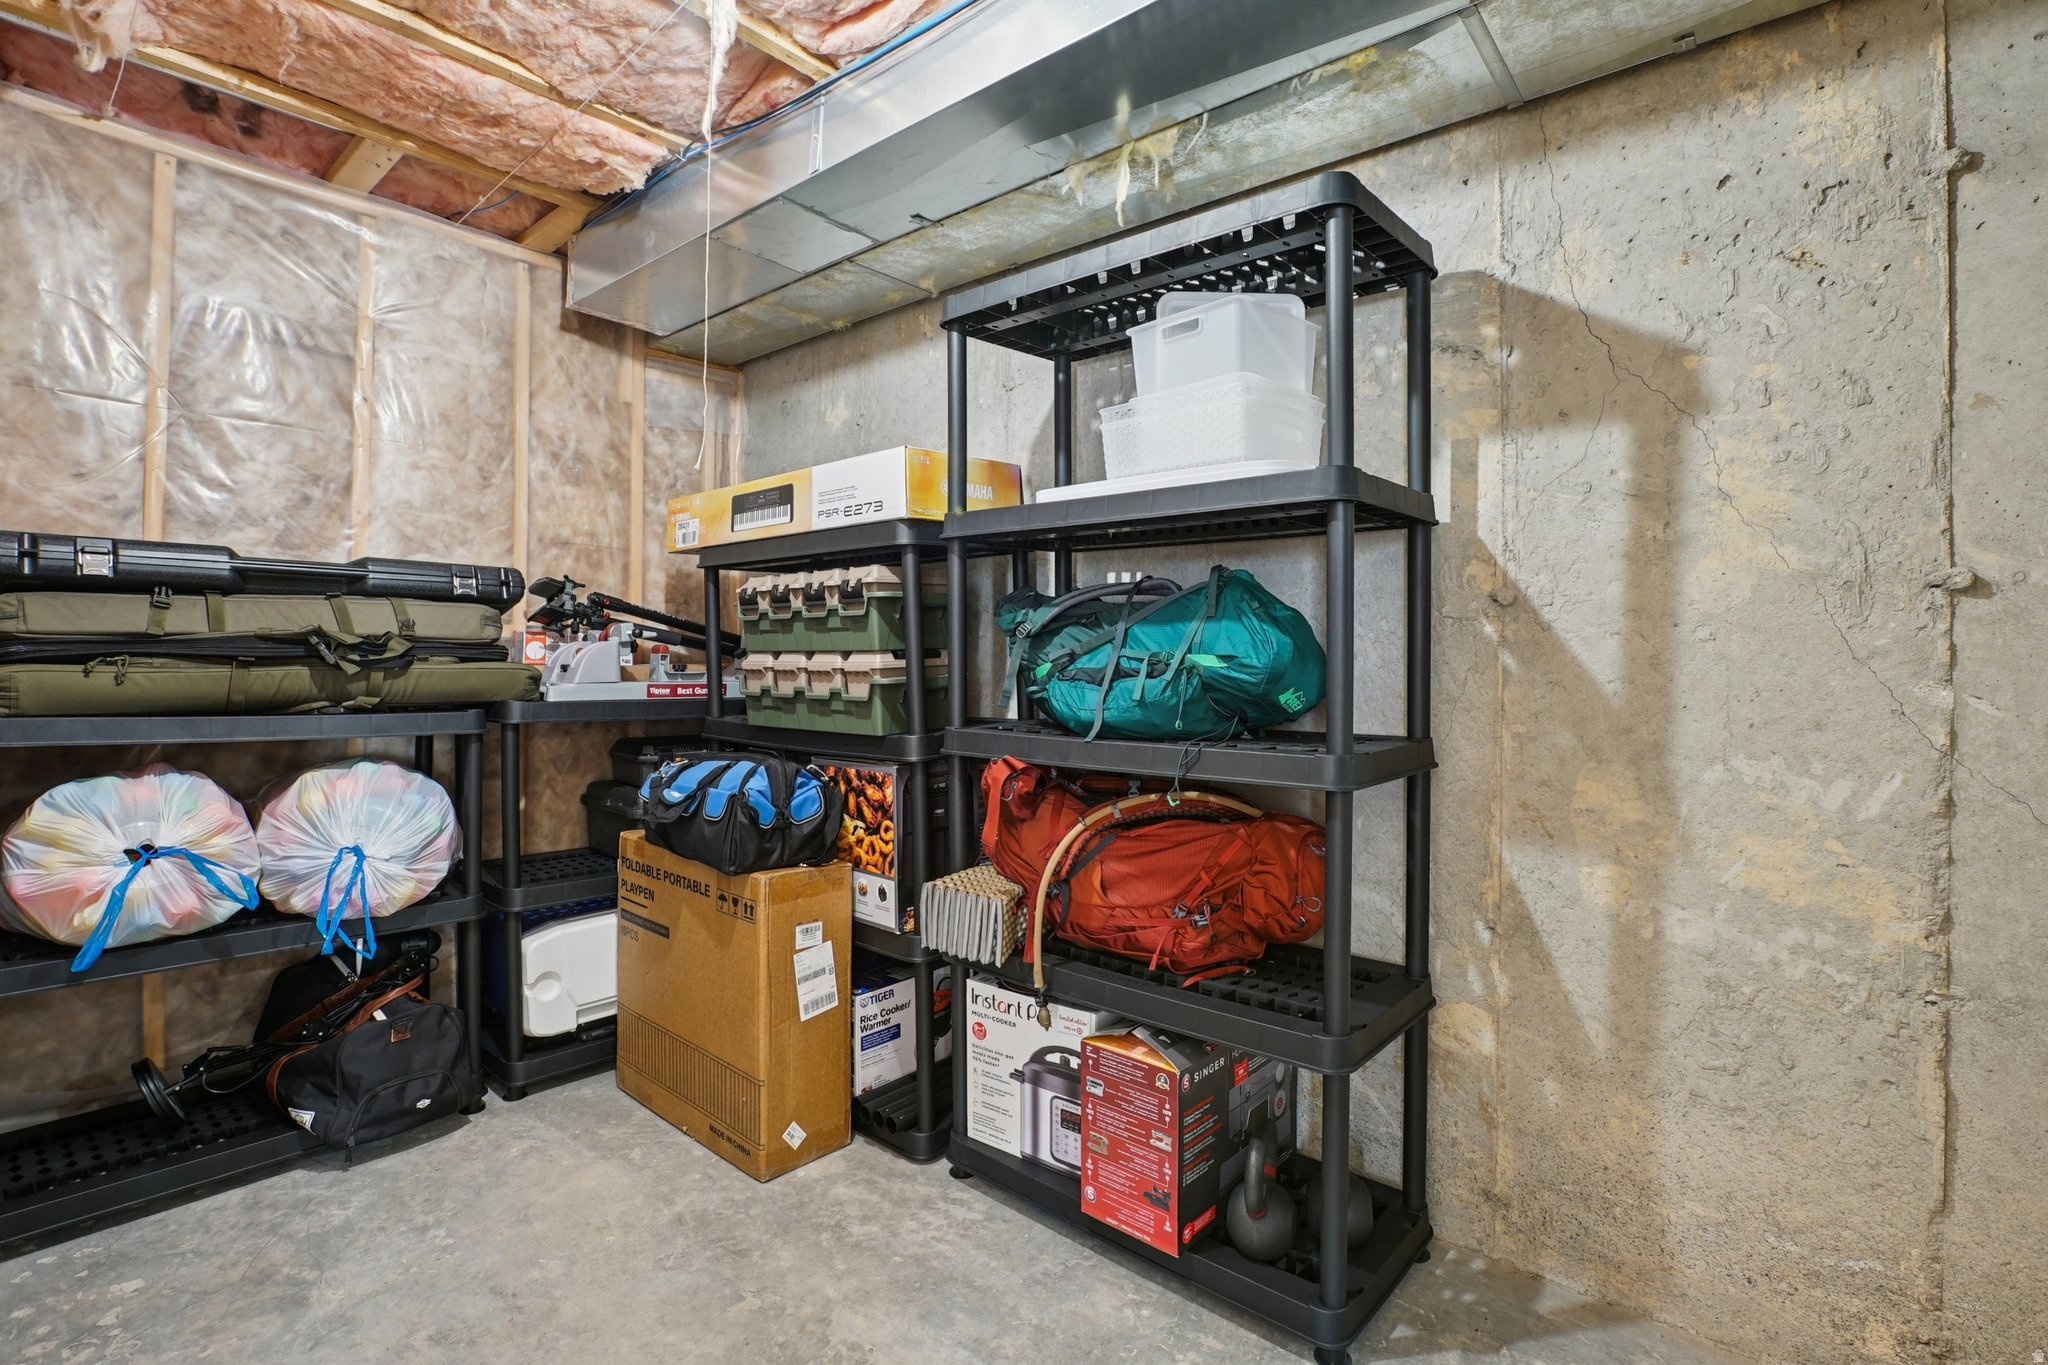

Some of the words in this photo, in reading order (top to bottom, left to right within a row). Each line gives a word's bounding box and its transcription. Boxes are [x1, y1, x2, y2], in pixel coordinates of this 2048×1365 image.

[967, 483, 993, 500] MAHA
[817, 500, 883, 519] PSR-E273
[677, 687, 693, 695] Best
[621, 856, 661, 881] FOLDABLE
[663, 870, 711, 898] PORTABLE
[621, 878, 654, 902] PLAYPEN
[869, 989, 895, 1005] TIGER
[971, 987, 1023, 1020] Instant
[860, 1011, 878, 1025] Rice
[880, 999, 912, 1018] Cooker/
[971, 1010, 1017, 1029] MULTI-COOKER
[860, 1017, 892, 1034] Warmer
[971, 1042, 994, 1054] Delicious
[971, 1049, 987, 1059] meals
[986, 1053, 1000, 1063] made
[1193, 1057, 1225, 1083] SINGER
[709, 1123, 725, 1140] MADE
[725, 1135, 732, 1145] IN
[732, 1138, 752, 1159] CHINA
